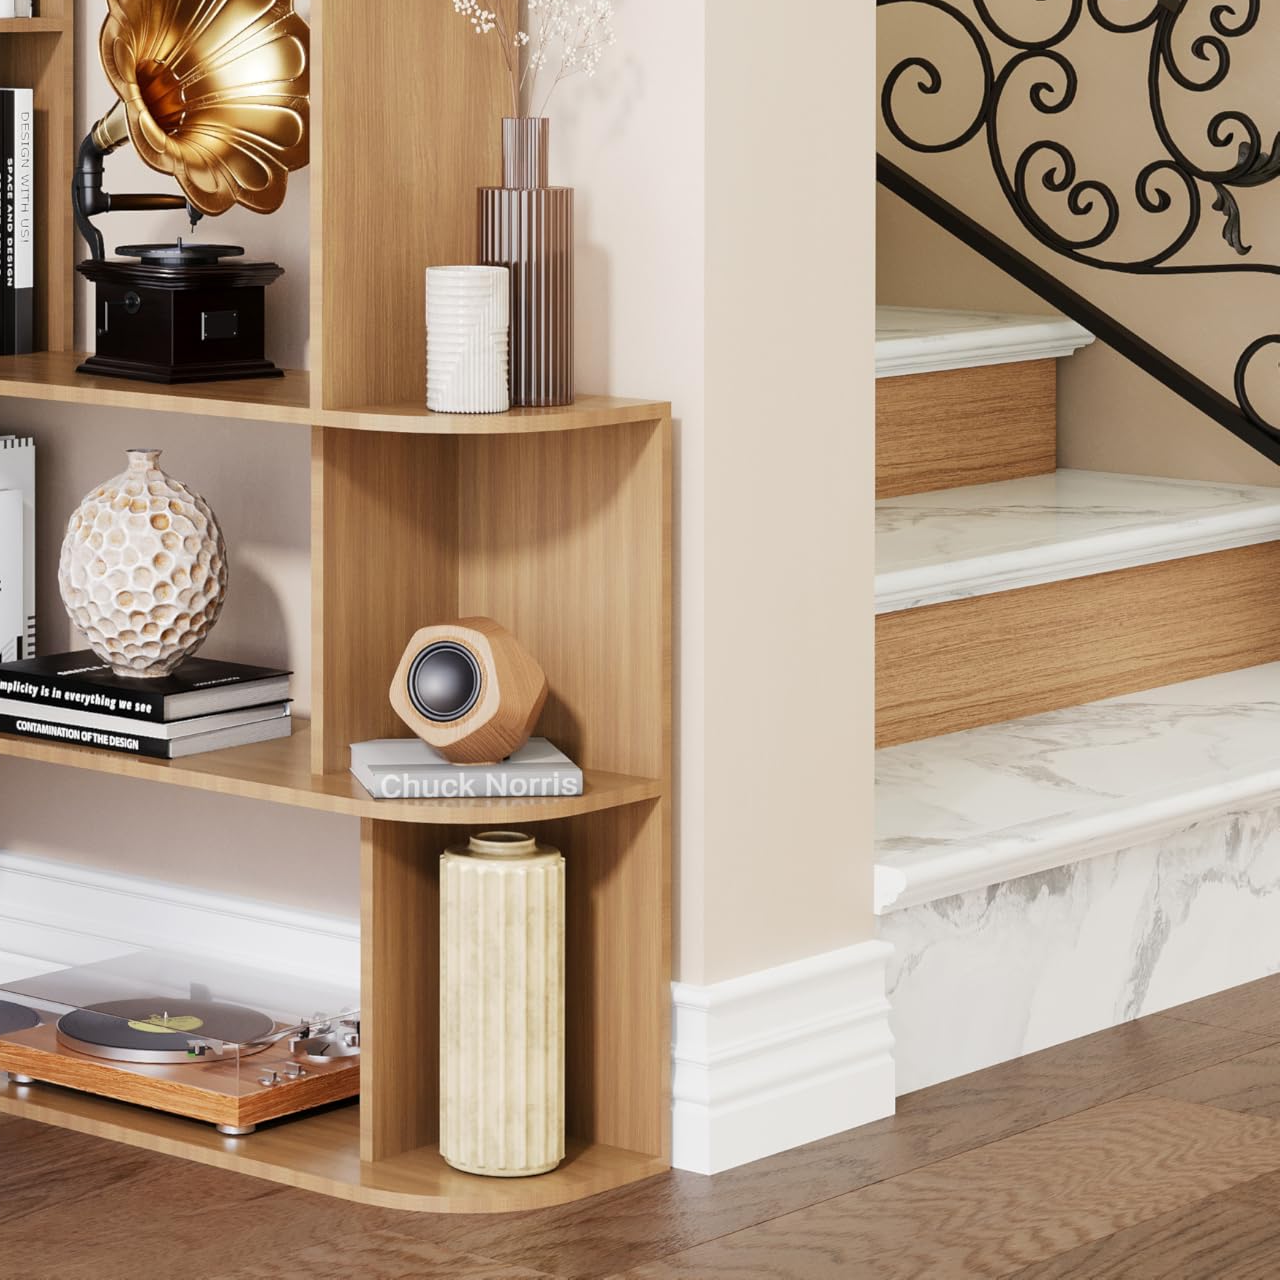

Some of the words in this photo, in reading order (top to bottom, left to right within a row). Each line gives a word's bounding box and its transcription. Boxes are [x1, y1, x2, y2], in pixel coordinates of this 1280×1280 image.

[20, 112, 30, 168] DESIGN
[20, 174, 30, 213] WITH
[20, 218, 30, 243] US!
[41, 685, 50, 698] is
[51, 687, 62, 700] in
[64, 689, 117, 711] everything
[119, 699, 133, 711] we
[134, 701, 152, 715] see
[16, 719, 81, 741] CONTAMINATION
[81, 730, 93, 742] OF
[93, 732, 109, 745] THE
[109, 734, 139, 751] DESIGN
[380, 772, 475, 799] Chuck
[486, 772, 578, 796] Norris
